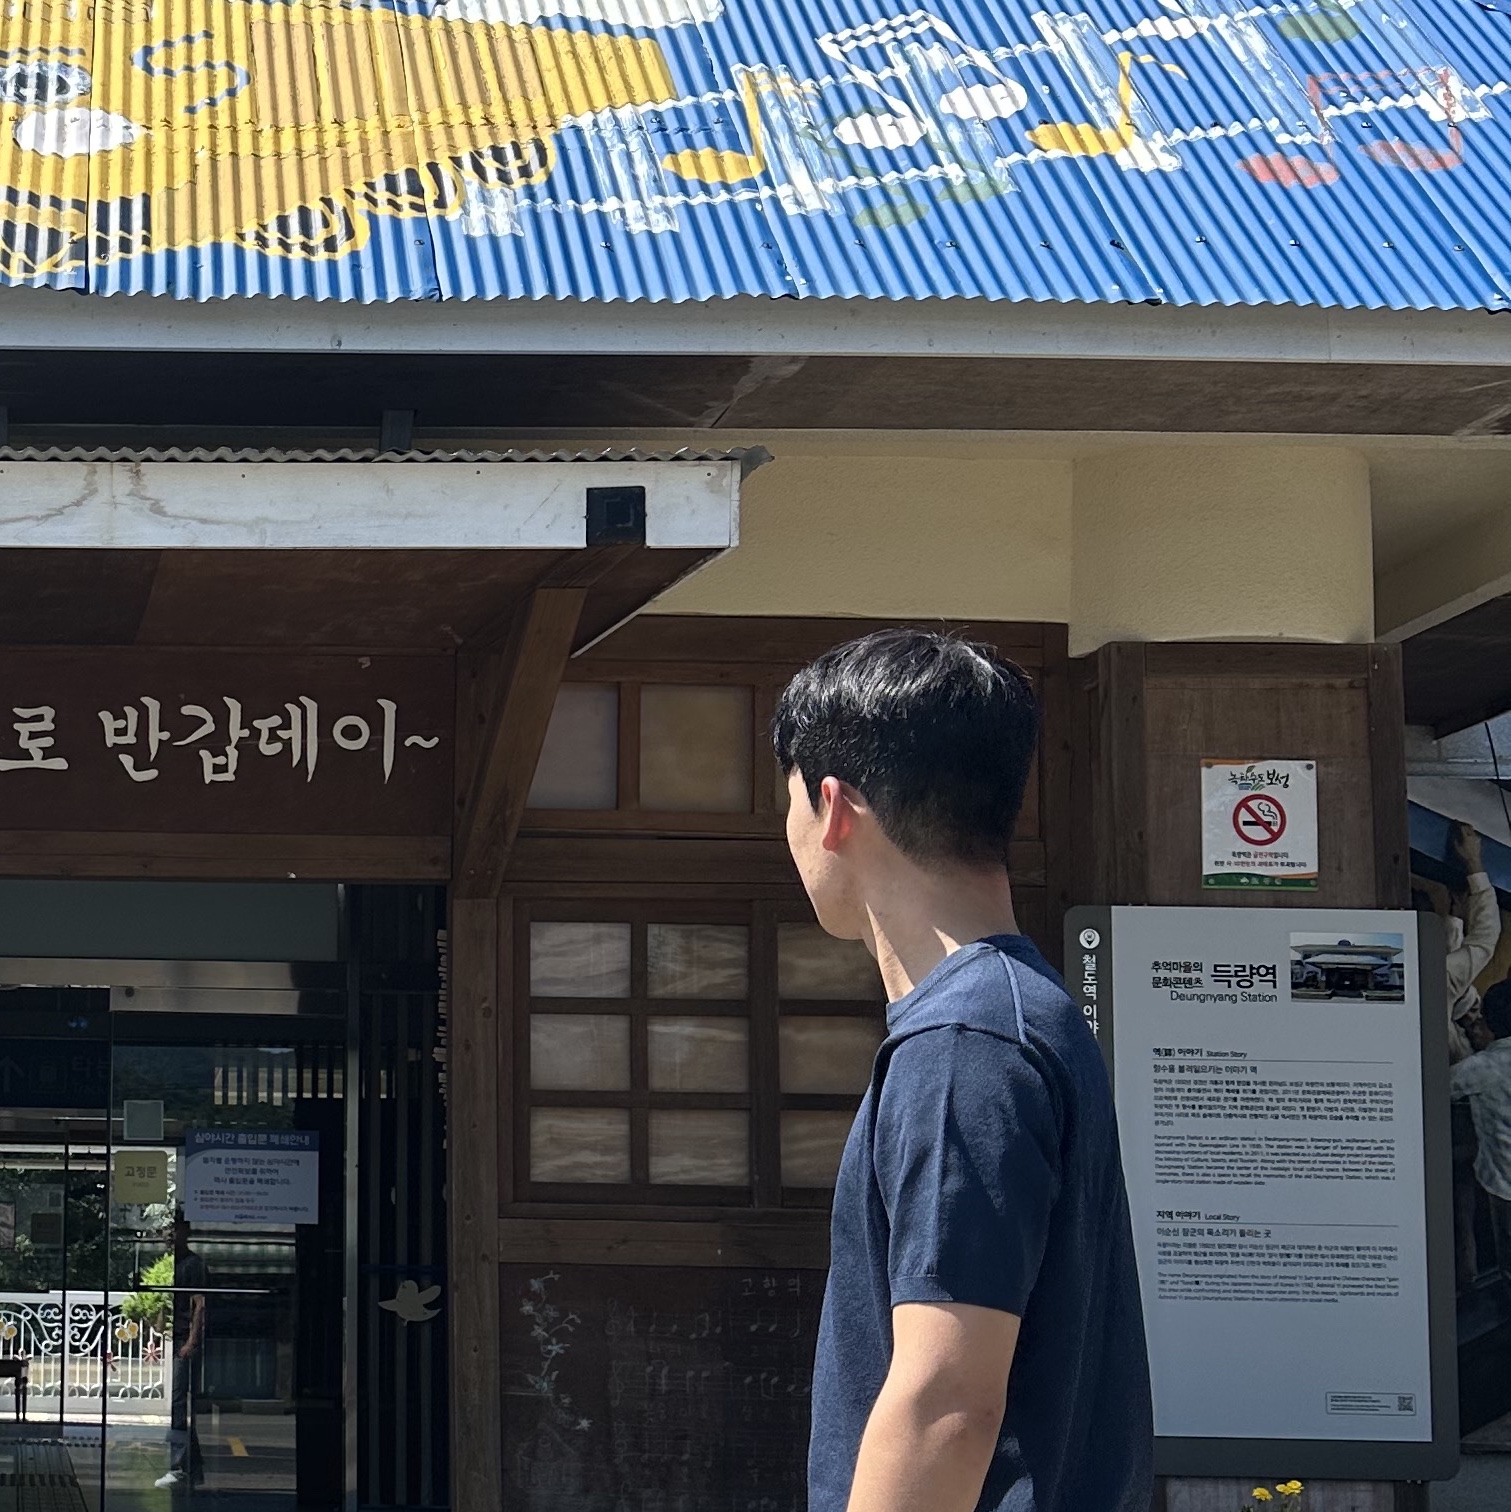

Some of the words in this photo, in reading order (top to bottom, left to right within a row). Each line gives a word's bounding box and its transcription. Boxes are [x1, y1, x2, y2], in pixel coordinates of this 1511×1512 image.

[97, 694, 441, 785] 반갑데이~
[1228, 771, 1266, 785] 녹차수도
[1266, 769, 1290, 789] 보성
[1151, 960, 1203, 974] 추억마을의
[1082, 954, 1098, 1001] 철도역
[1152, 977, 1204, 989] 문화콘텐츠
[1211, 964, 1277, 989] 득량역
[1170, 991, 1238, 1004] Deungnyang
[1240, 992, 1278, 1003] Station
[1083, 1004, 1100, 1040] 이야
[1178, 1048, 1203, 1057] 이야기
[1230, 1051, 1247, 1059] Story
[194, 1132, 236, 1144] 심야시간
[237, 1133, 268, 1145] 출입문
[125, 1166, 157, 1179] 고정문
[1156, 1210, 1173, 1220] 지역
[1176, 1211, 1201, 1220] 이야기
[1222, 1214, 1240, 1223] Story
[741, 1273, 802, 1298] 고향의
